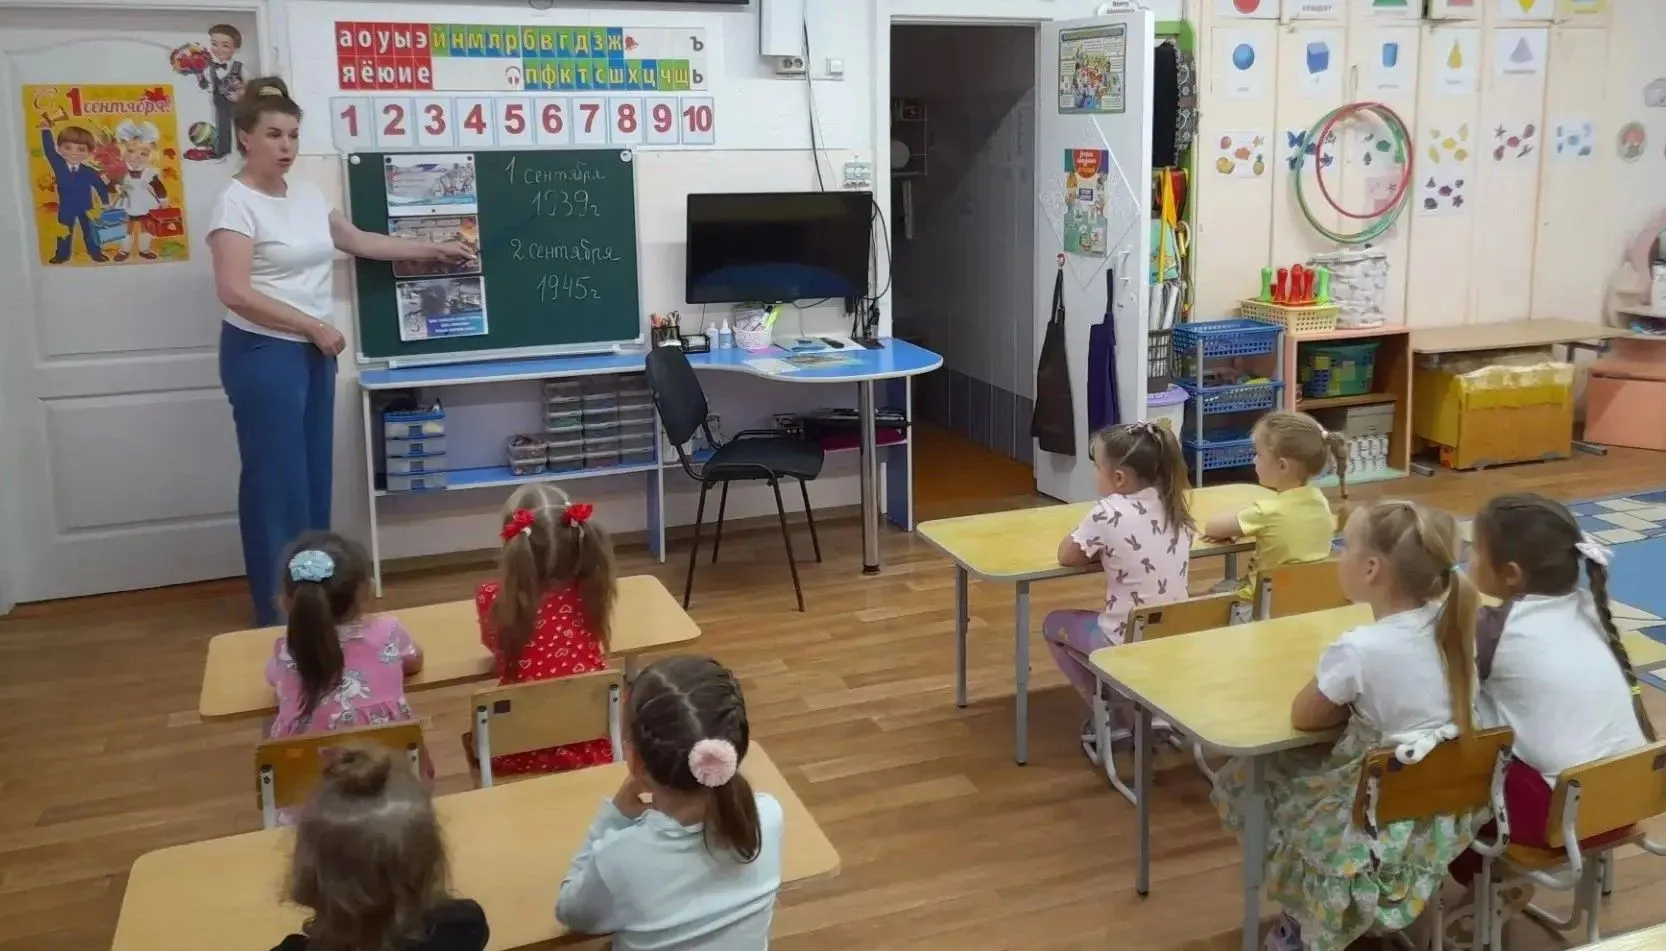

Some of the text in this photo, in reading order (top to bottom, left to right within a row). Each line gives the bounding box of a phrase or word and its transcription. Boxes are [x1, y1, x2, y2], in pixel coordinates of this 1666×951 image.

[340, 104, 712, 137] 1 2 3 4 5 6 7 8 9 10
[505, 156, 516, 184] 1
[510, 238, 525, 260] 2
